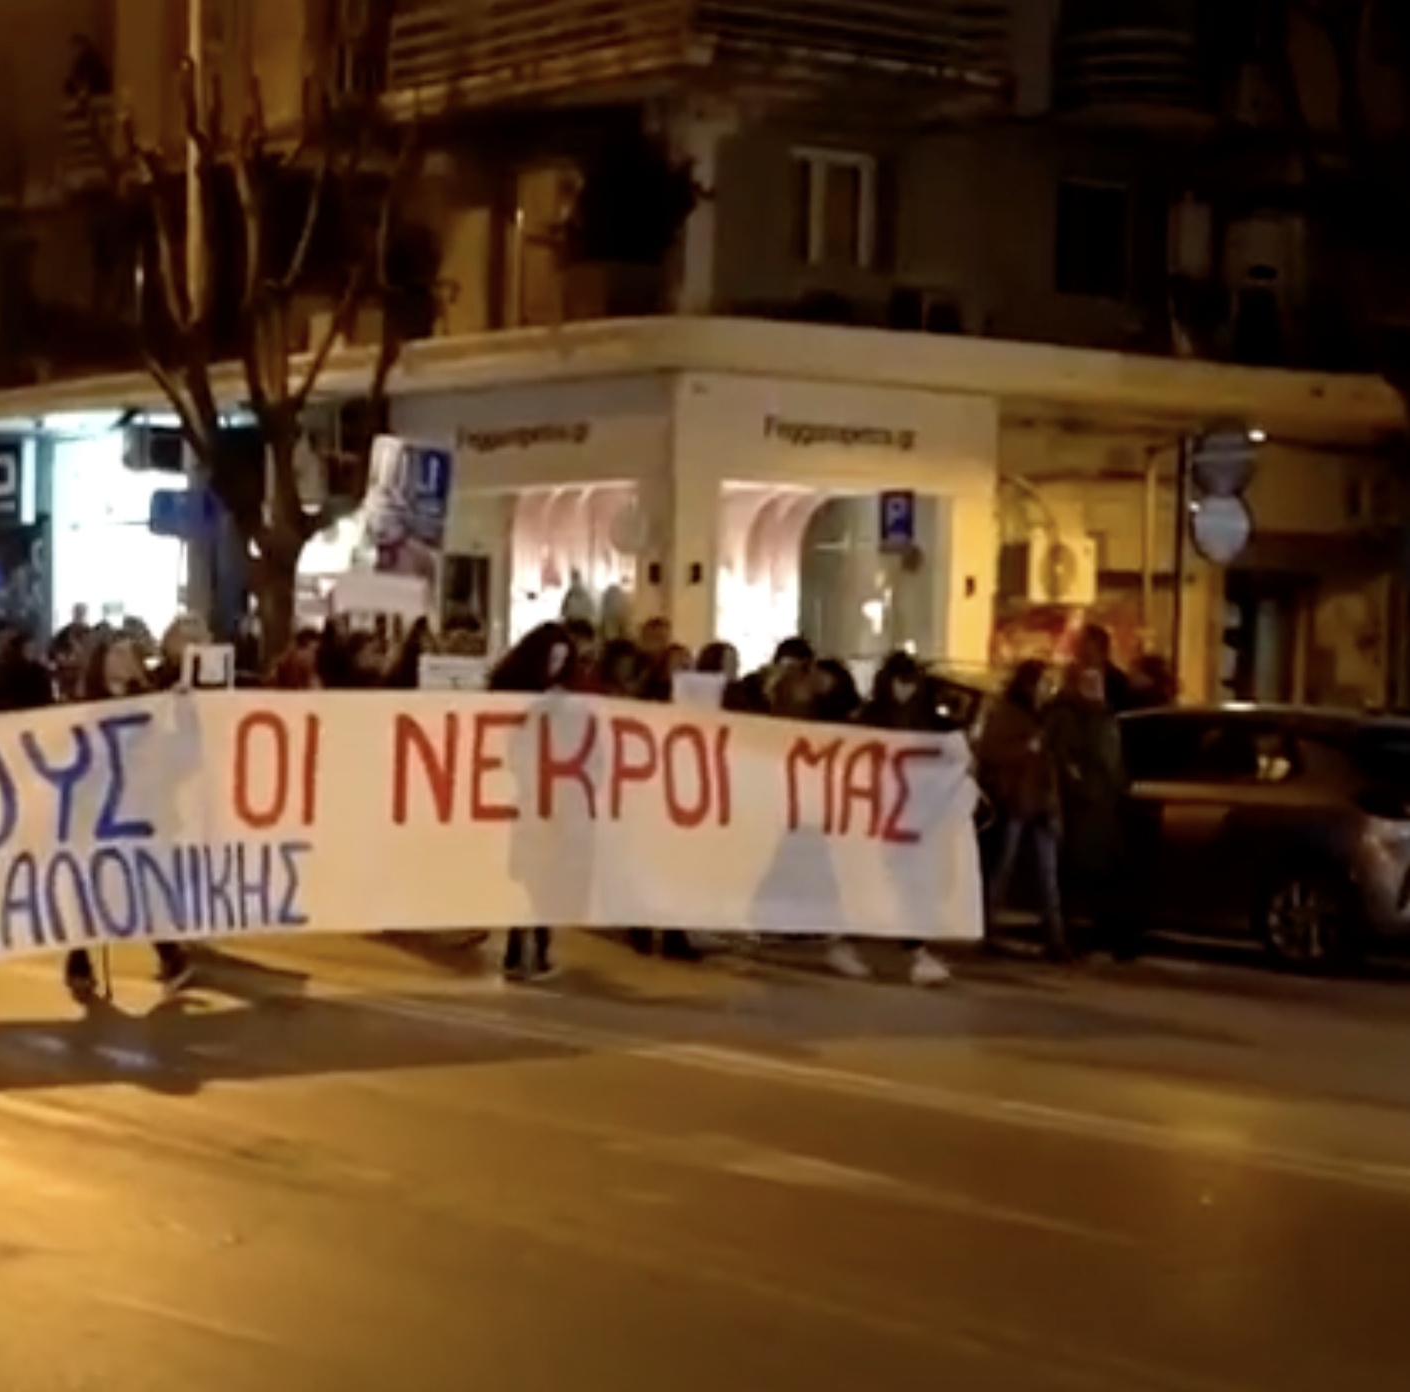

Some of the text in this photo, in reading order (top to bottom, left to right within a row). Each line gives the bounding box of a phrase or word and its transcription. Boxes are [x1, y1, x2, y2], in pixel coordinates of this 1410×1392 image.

[886, 498, 909, 530] P
[233, 711, 319, 827] ΟΙ
[392, 713, 732, 827] ΝΕΚΡΟΙ
[785, 736, 942, 842] ΜΑΣ
